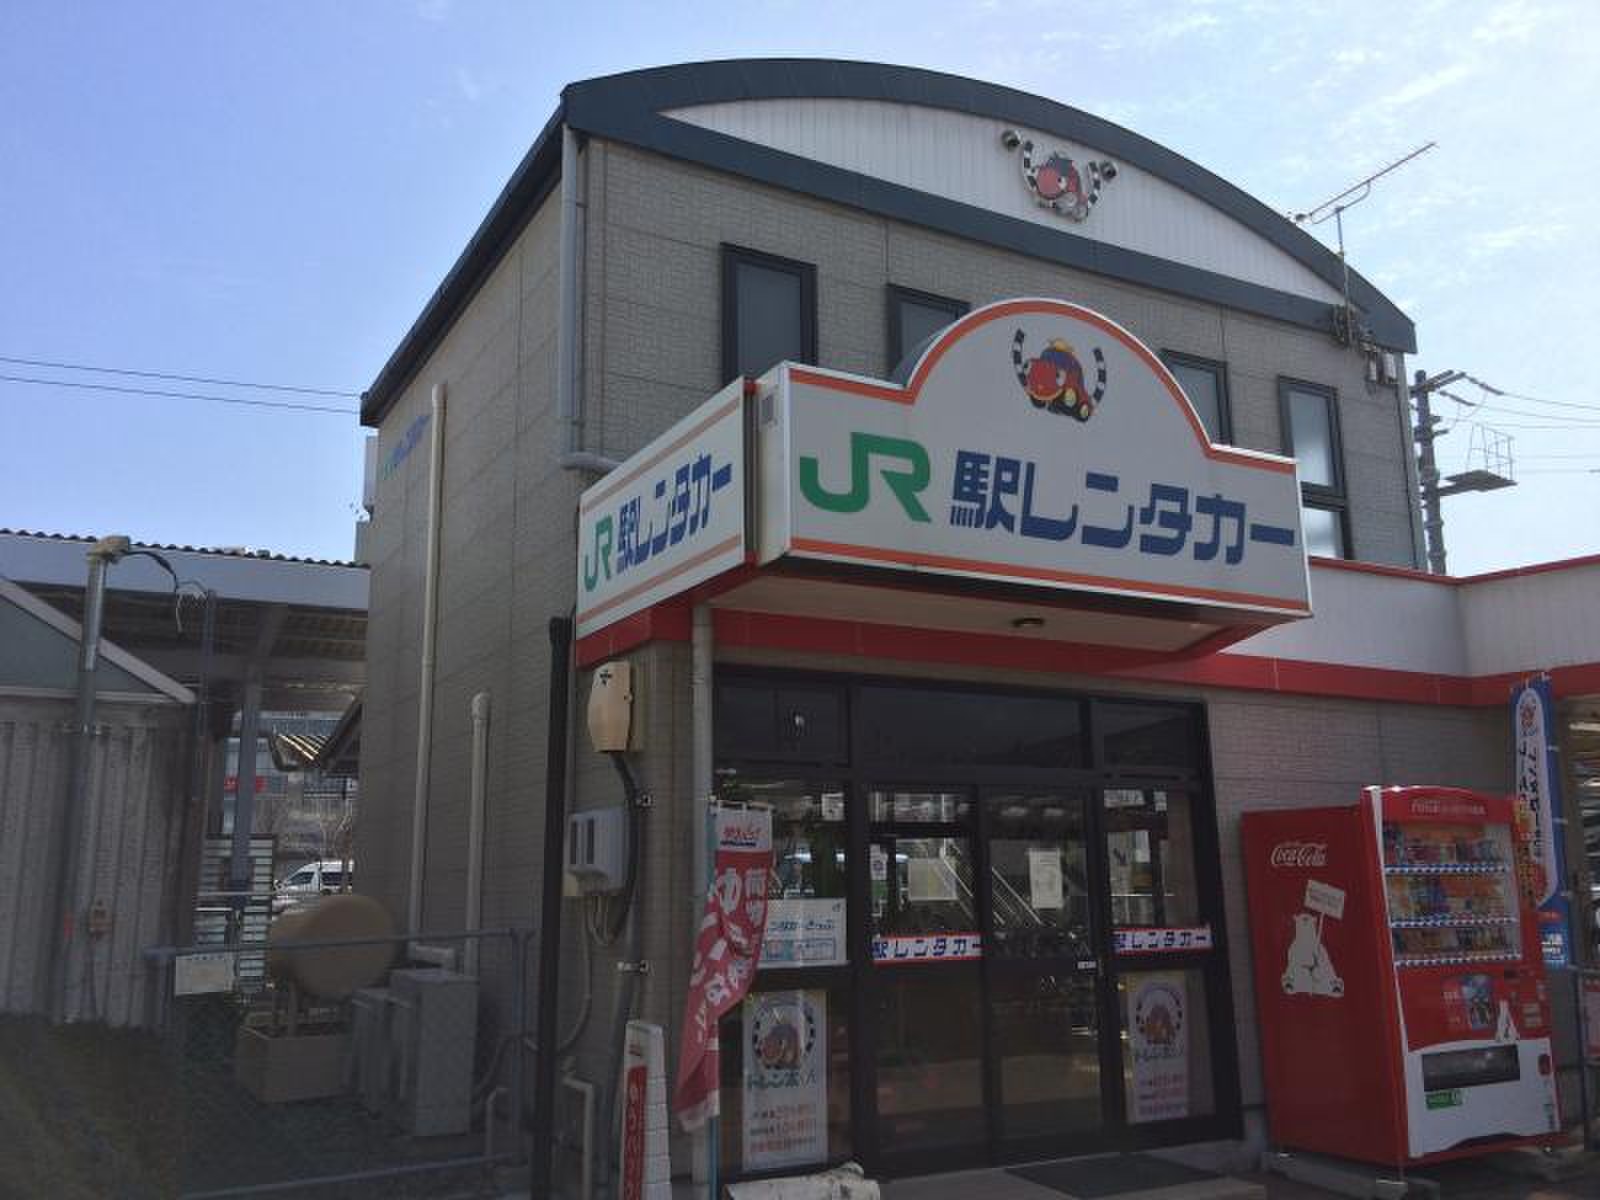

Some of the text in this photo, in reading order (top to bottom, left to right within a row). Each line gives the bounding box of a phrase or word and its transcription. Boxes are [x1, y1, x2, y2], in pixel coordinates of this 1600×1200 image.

[584, 455, 732, 593] JR 駅レンタカー
[800, 432, 1295, 565] JR 駅レンタカー
